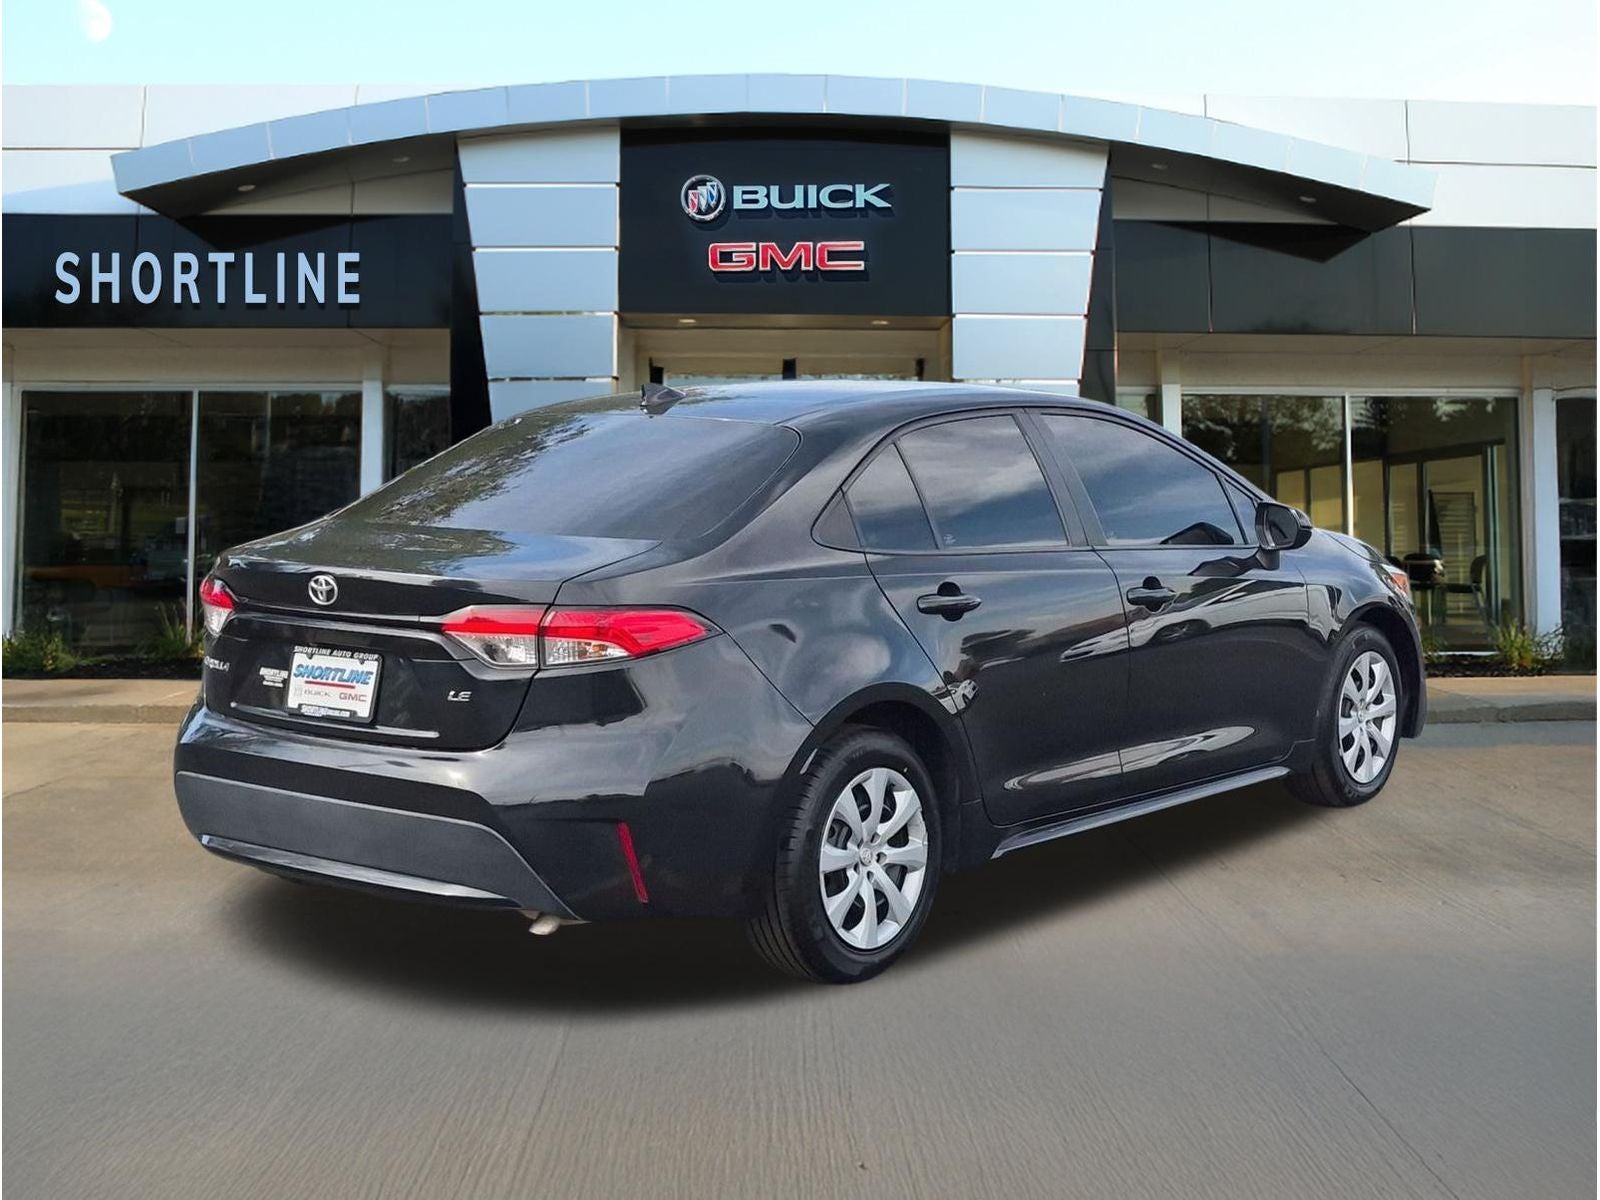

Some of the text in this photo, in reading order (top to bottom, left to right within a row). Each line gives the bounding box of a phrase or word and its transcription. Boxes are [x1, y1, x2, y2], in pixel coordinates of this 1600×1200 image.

[733, 183, 892, 210] BUICK
[708, 241, 865, 272] GMC
[54, 251, 361, 304] SHORTLINE
[293, 645, 380, 661] SHORTLINE AUTO GROUP
[293, 663, 375, 686] SHORTLINE
[303, 688, 368, 703] BUICK GMC
[447, 690, 473, 702] LE
